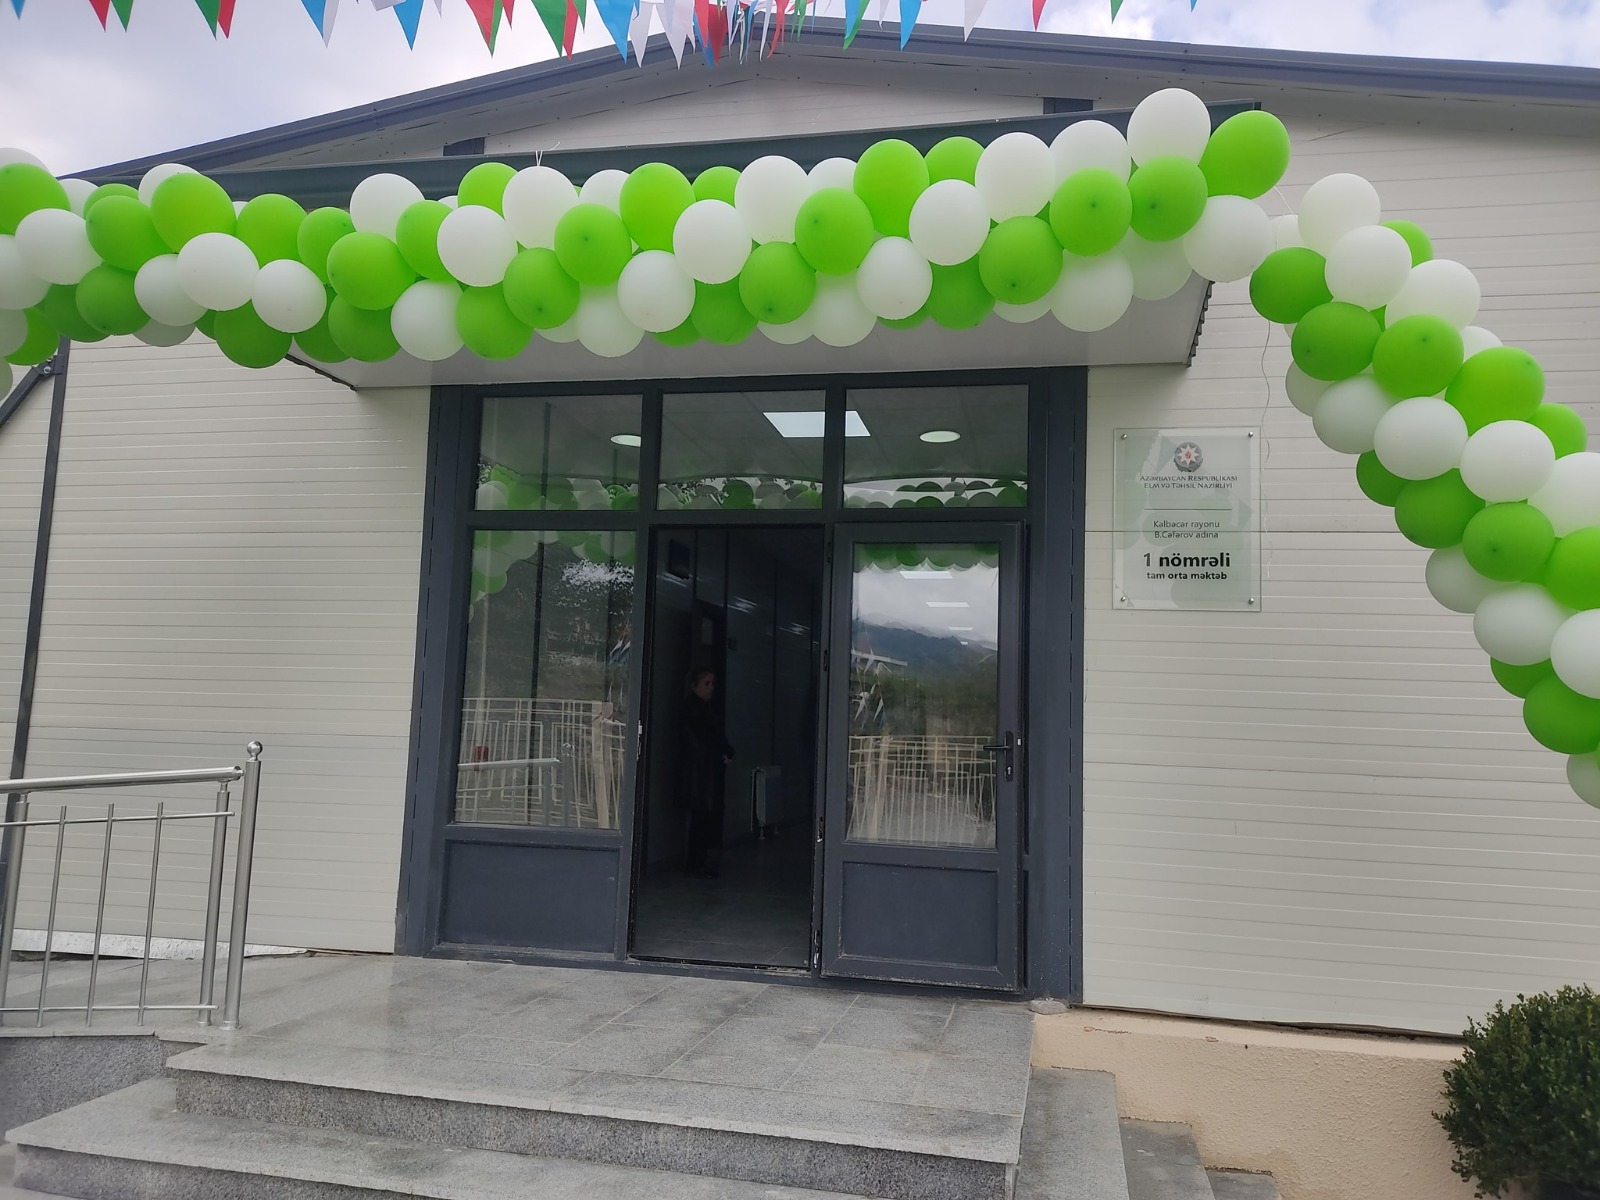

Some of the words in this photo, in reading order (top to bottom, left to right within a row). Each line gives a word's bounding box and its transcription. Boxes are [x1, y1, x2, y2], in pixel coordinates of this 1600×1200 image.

[1153, 520, 1188, 528] Kəlbəcər
[1191, 521, 1220, 530] rayonu
[1154, 531, 1193, 539] B.Cəfərov
[1143, 552, 1151, 567] 1
[1159, 552, 1230, 568] nömrəli
[1146, 572, 1165, 580] tam
[1167, 572, 1188, 580] orta
[1190, 571, 1228, 580] məktəb
